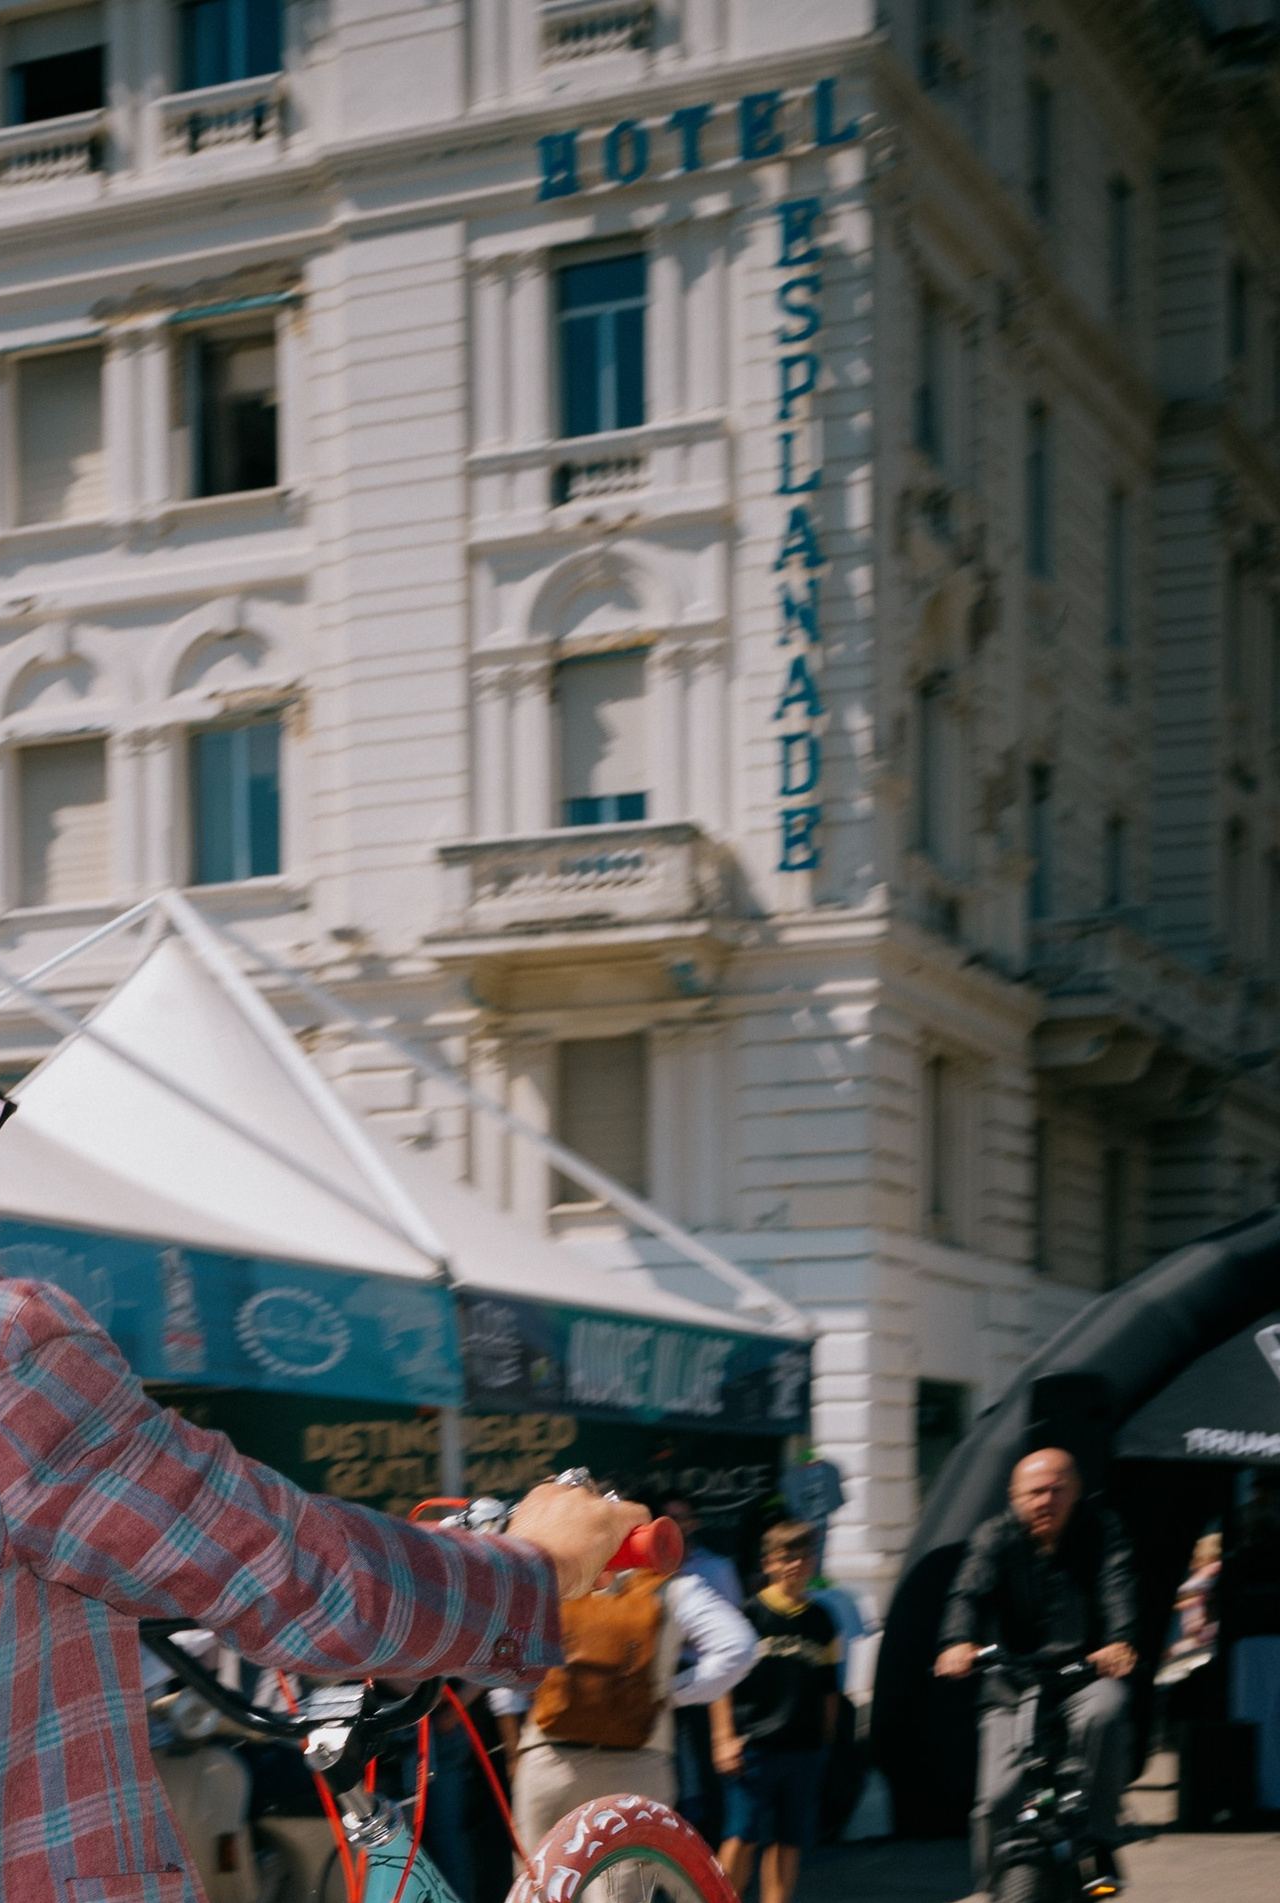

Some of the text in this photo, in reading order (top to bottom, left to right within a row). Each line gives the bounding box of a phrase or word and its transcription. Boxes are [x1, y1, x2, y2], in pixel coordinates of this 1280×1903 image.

[536, 78, 860, 201] HOTEL
[773, 198, 829, 872] ESPLANADE
[303, 1414, 578, 1462] DISTINGISHED
